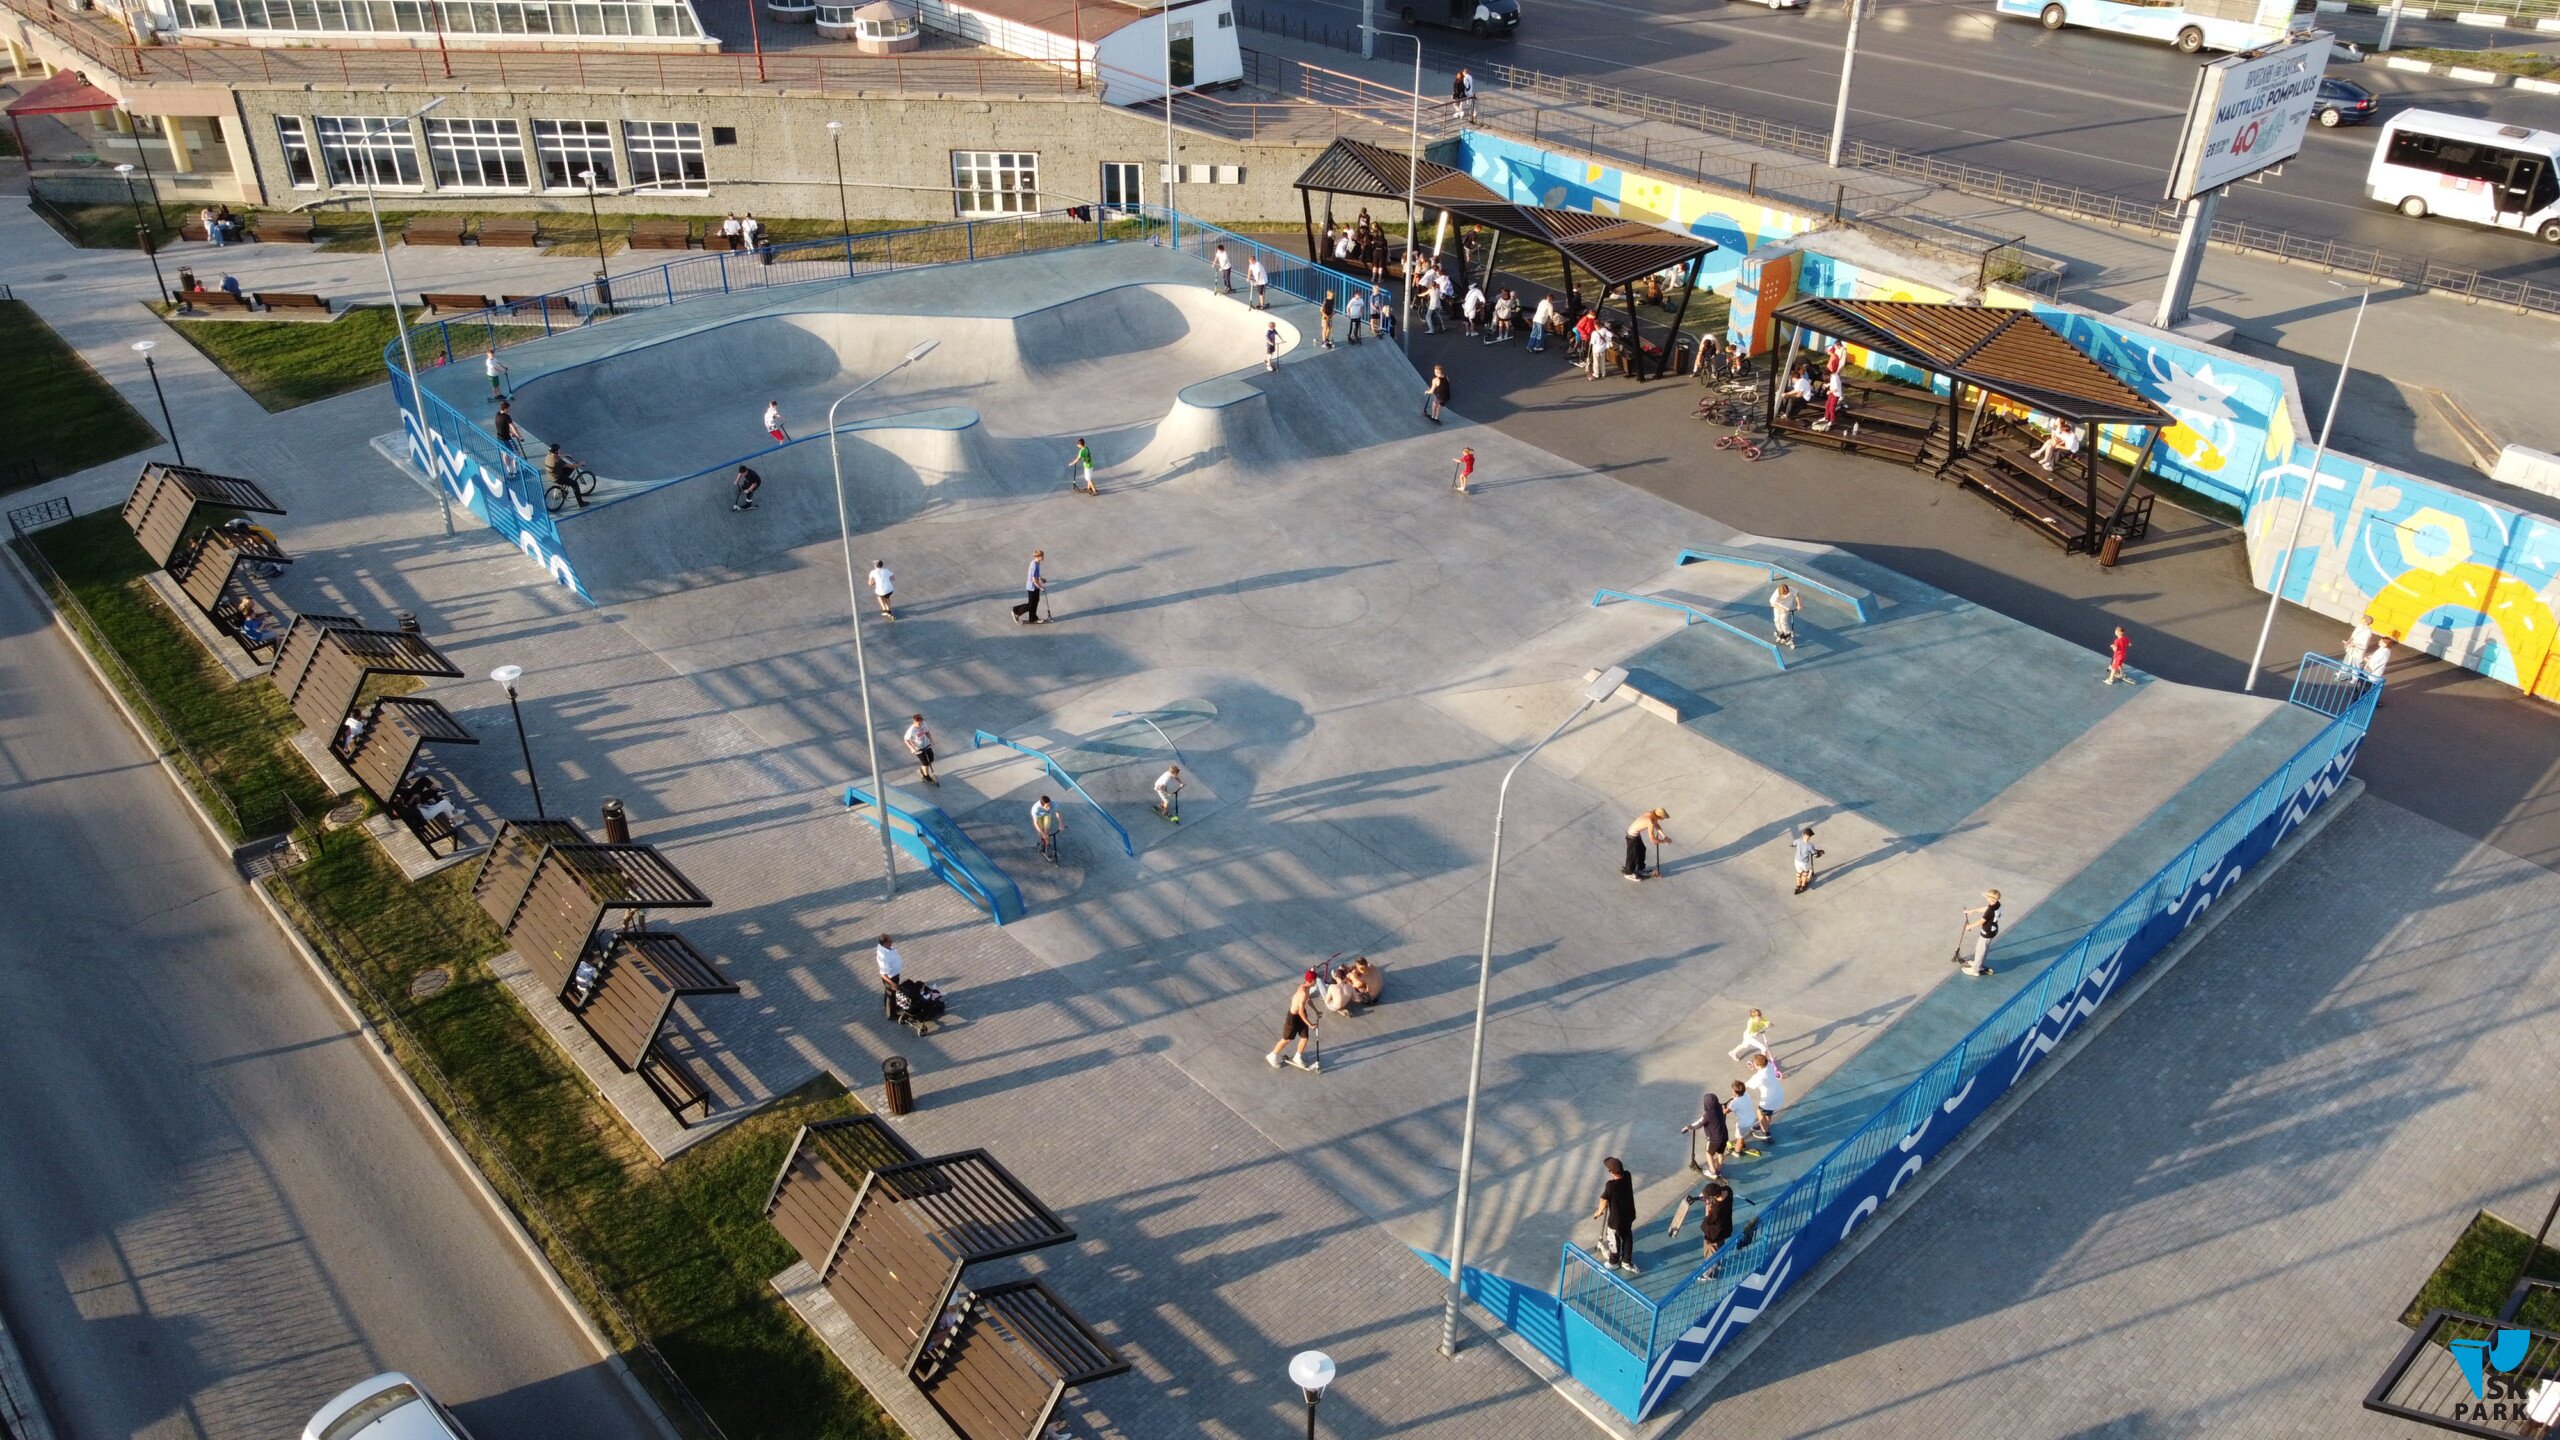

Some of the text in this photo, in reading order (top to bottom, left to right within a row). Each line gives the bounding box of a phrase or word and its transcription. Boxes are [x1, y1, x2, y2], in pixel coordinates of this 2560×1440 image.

[2215, 75, 2317, 125] NAUTILUS POMPILIUS
[2205, 142, 2216, 158] 28
[2230, 121, 2259, 156] 40
